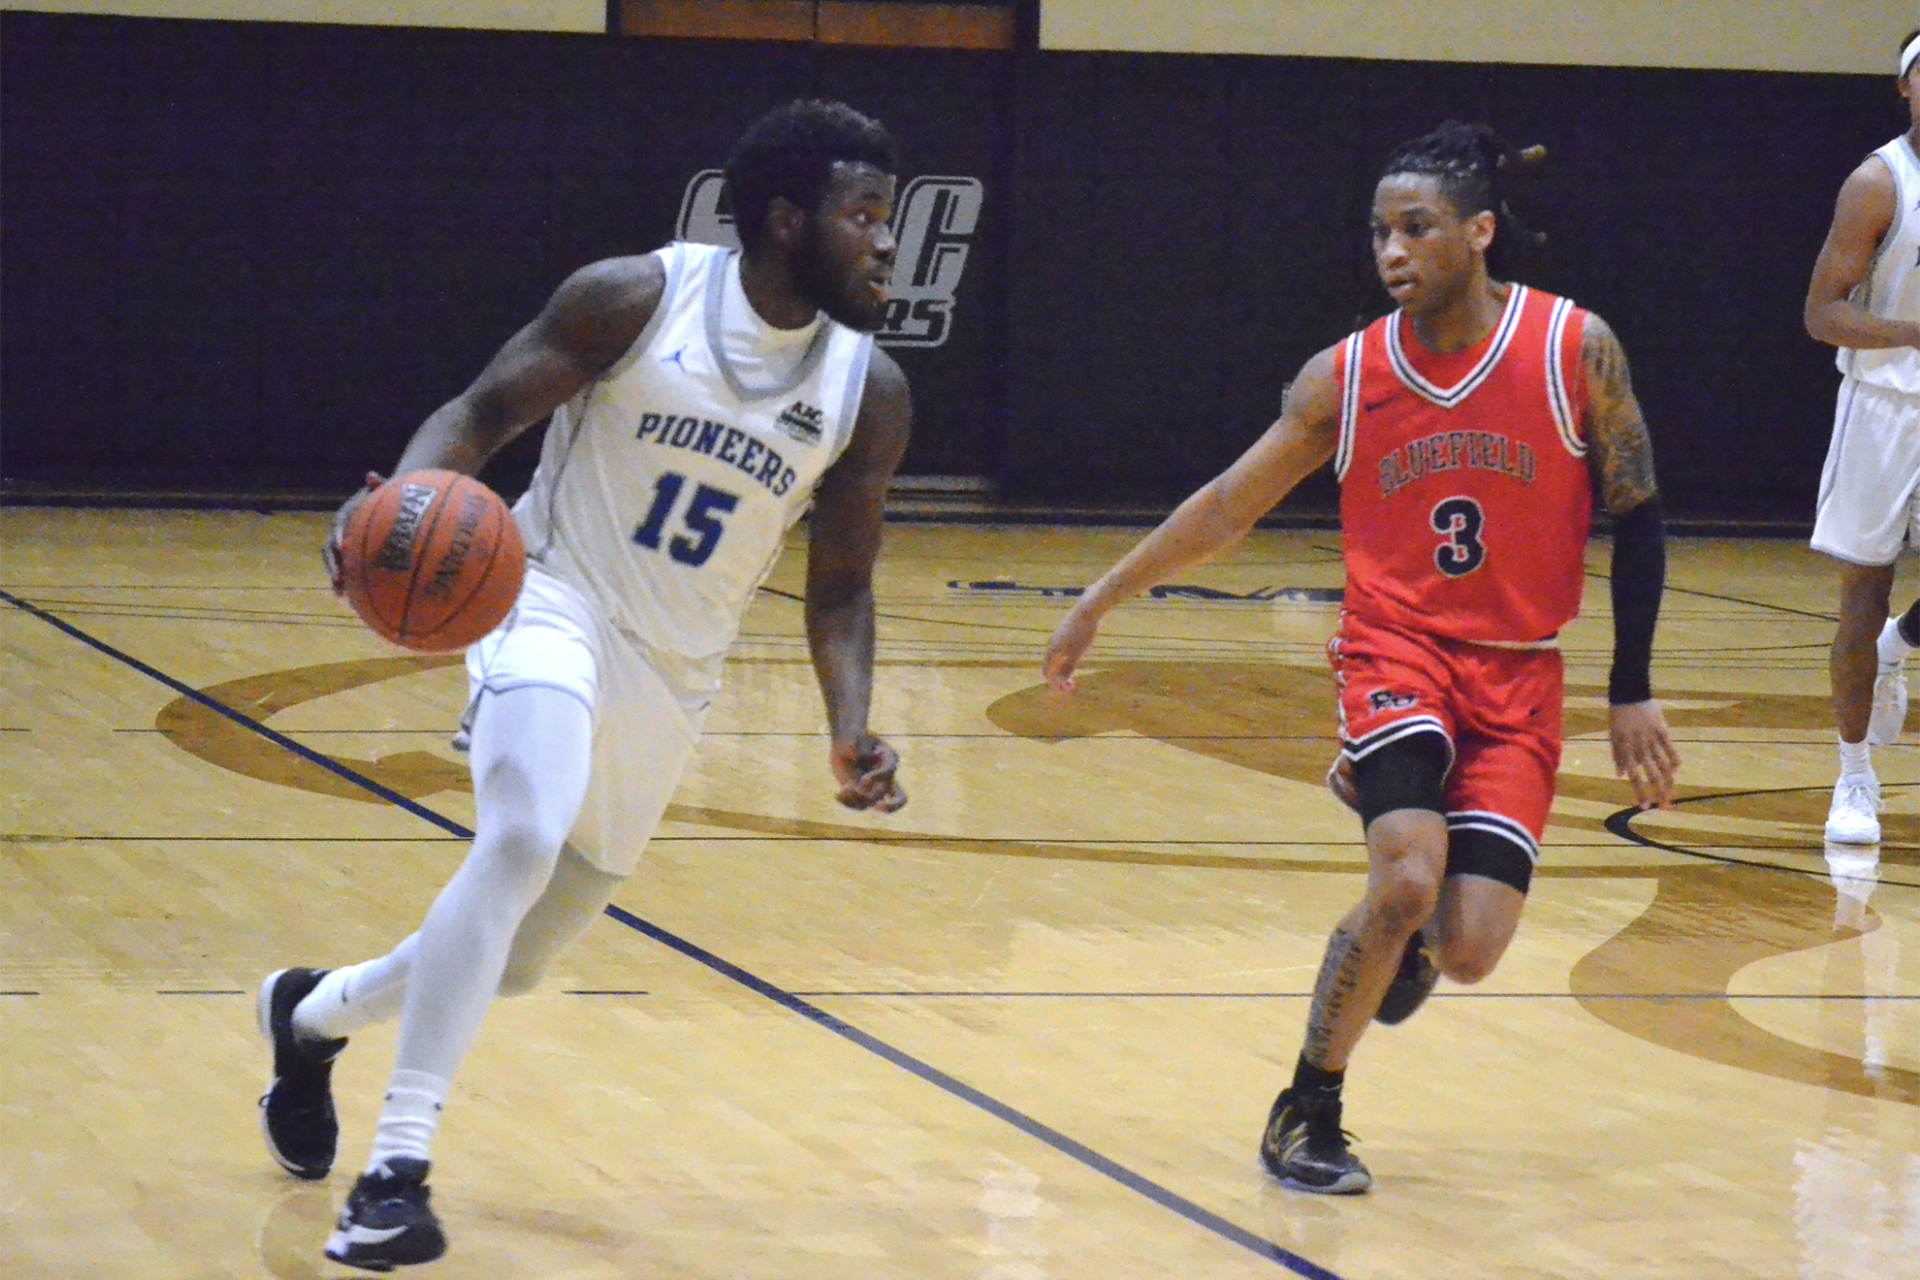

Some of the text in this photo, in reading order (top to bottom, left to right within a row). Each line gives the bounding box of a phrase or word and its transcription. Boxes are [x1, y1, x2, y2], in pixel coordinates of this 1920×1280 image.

[635, 412, 796, 498] PIONEERS
[1379, 430, 1537, 498] BLUEFIELD
[631, 470, 742, 568] 15
[1430, 495, 1487, 578] 3
